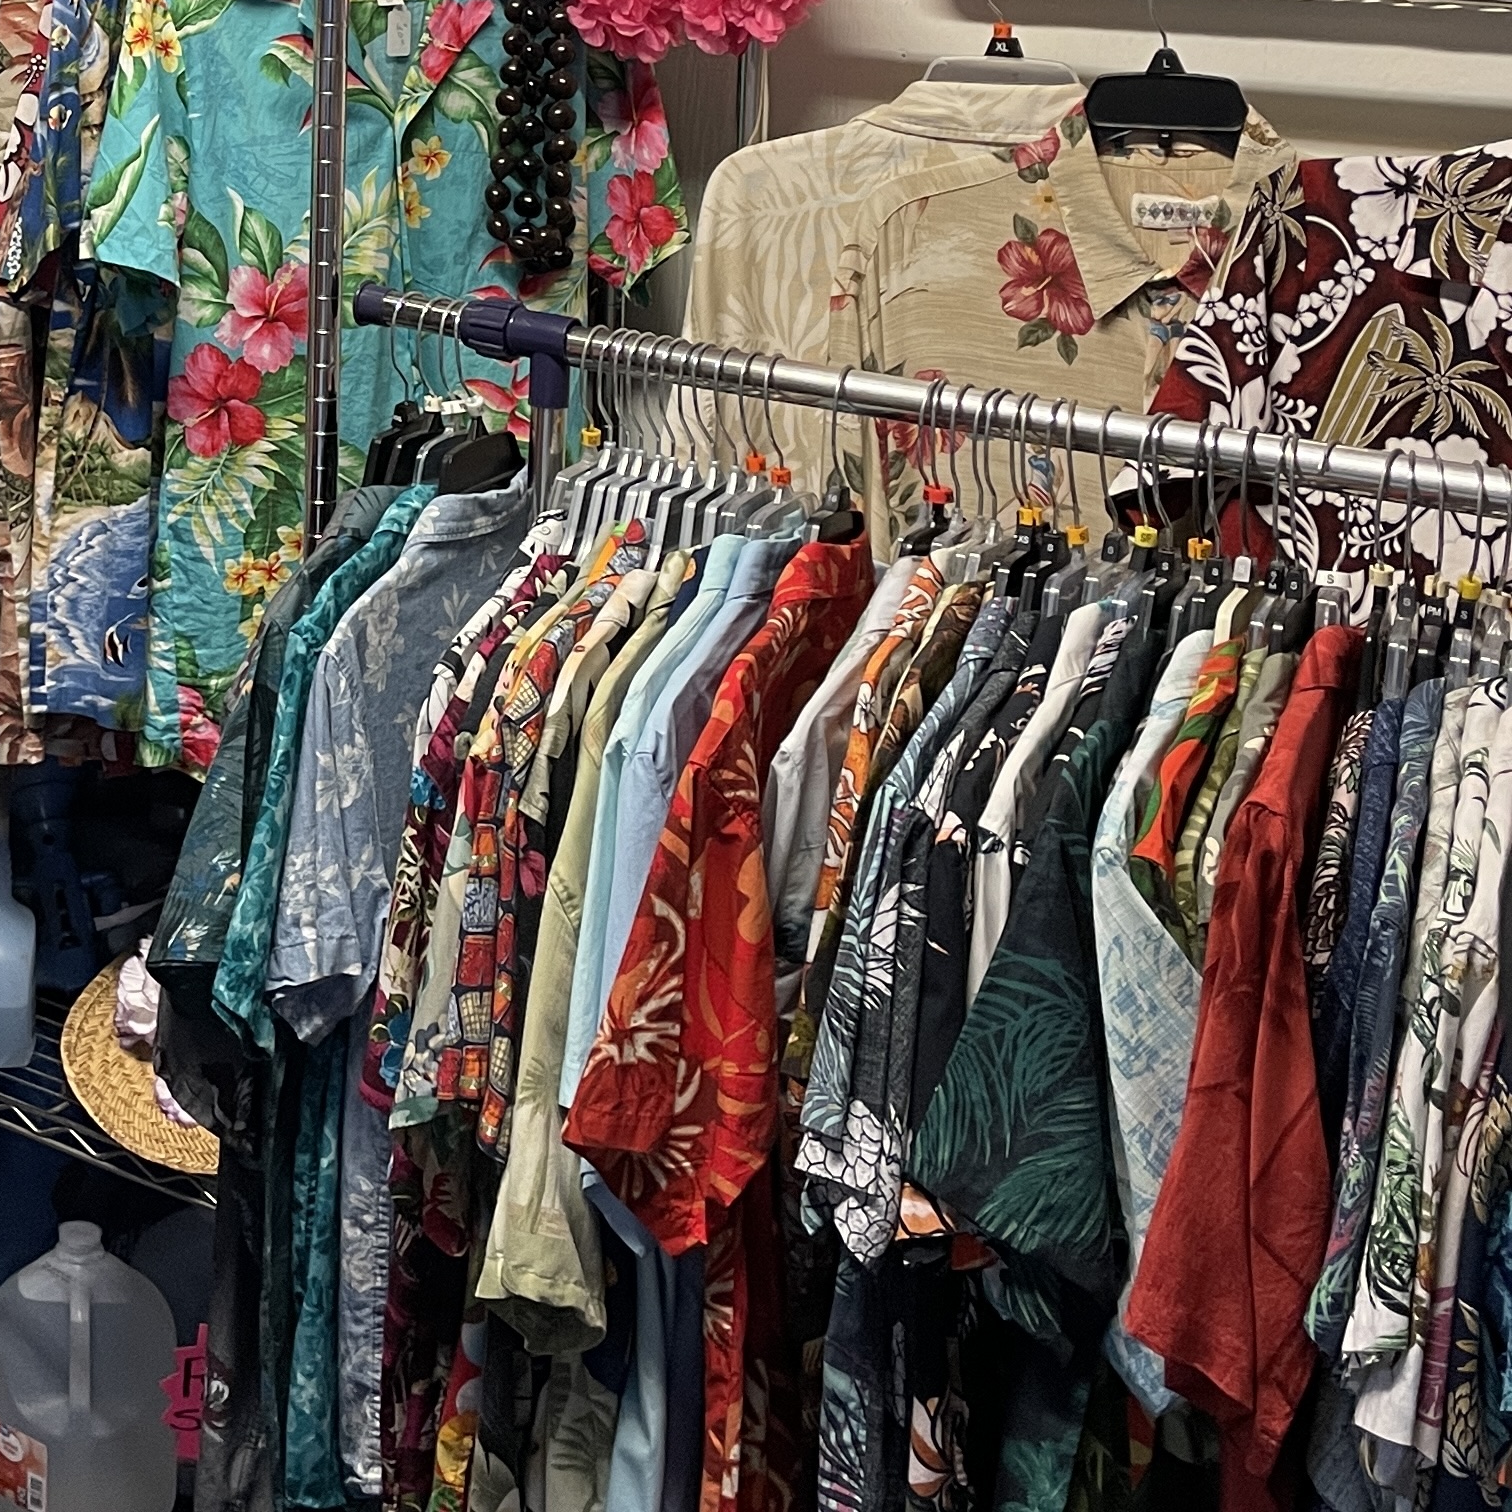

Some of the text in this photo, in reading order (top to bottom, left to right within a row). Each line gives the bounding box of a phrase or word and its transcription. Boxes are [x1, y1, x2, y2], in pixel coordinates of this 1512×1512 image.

[995, 41, 1009, 53] XL
[1162, 58, 1170, 69] L
[1162, 561, 1169, 571] S
[1327, 574, 1334, 585] S
[1290, 581, 1297, 590] S
[1403, 597, 1411, 607] S
[1427, 606, 1442, 616] PM
[1460, 610, 1468, 620] S
